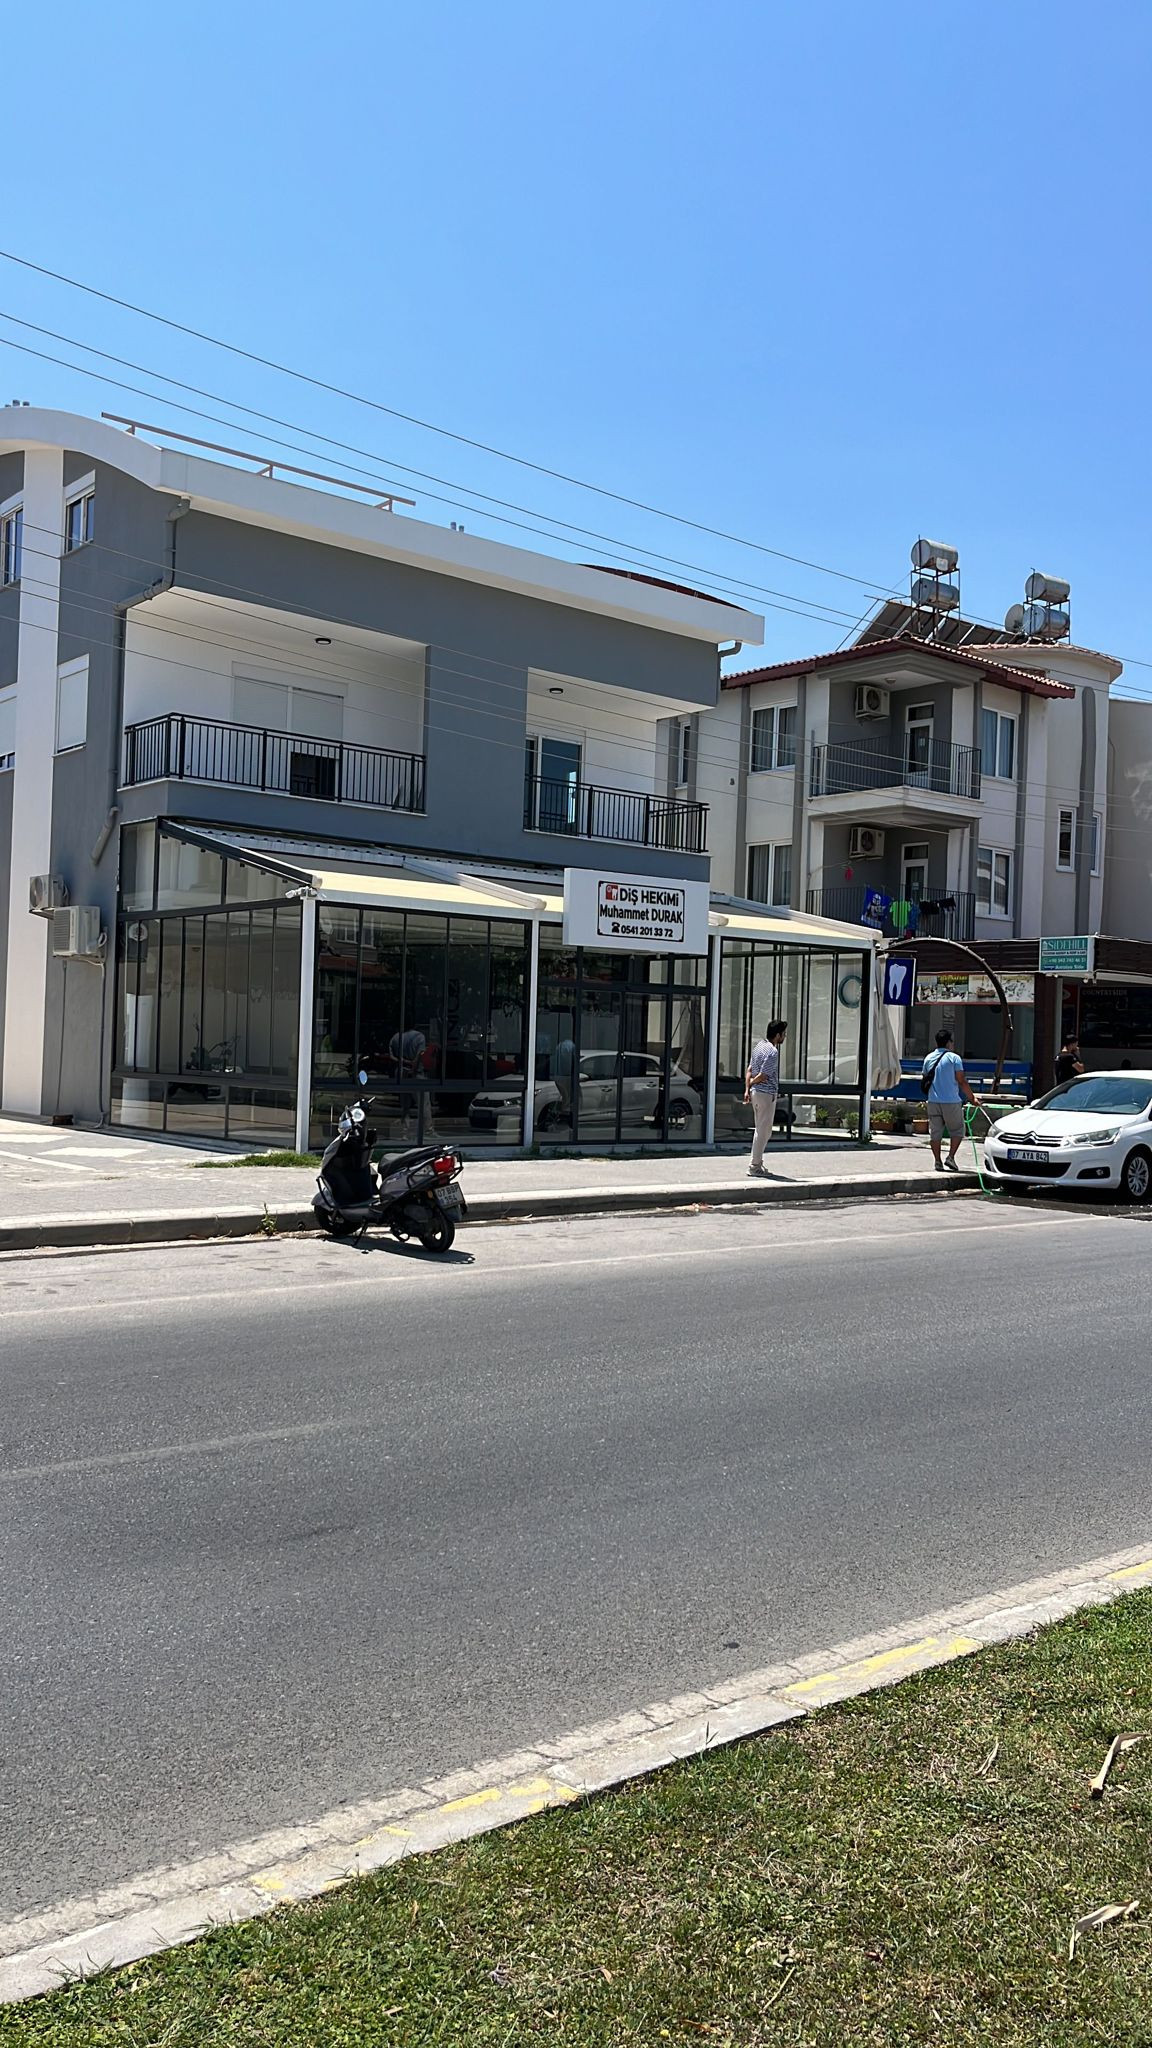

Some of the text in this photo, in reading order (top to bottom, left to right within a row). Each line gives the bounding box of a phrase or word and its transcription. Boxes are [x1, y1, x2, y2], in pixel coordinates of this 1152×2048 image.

[599, 904, 683, 923] Muhammet DURAK
[620, 924, 674, 938] 0541 201 33 72
[1022, 1151, 1034, 1160] AYA
[1035, 1152, 1047, 1161] 842
[437, 1189, 445, 1198] 07
